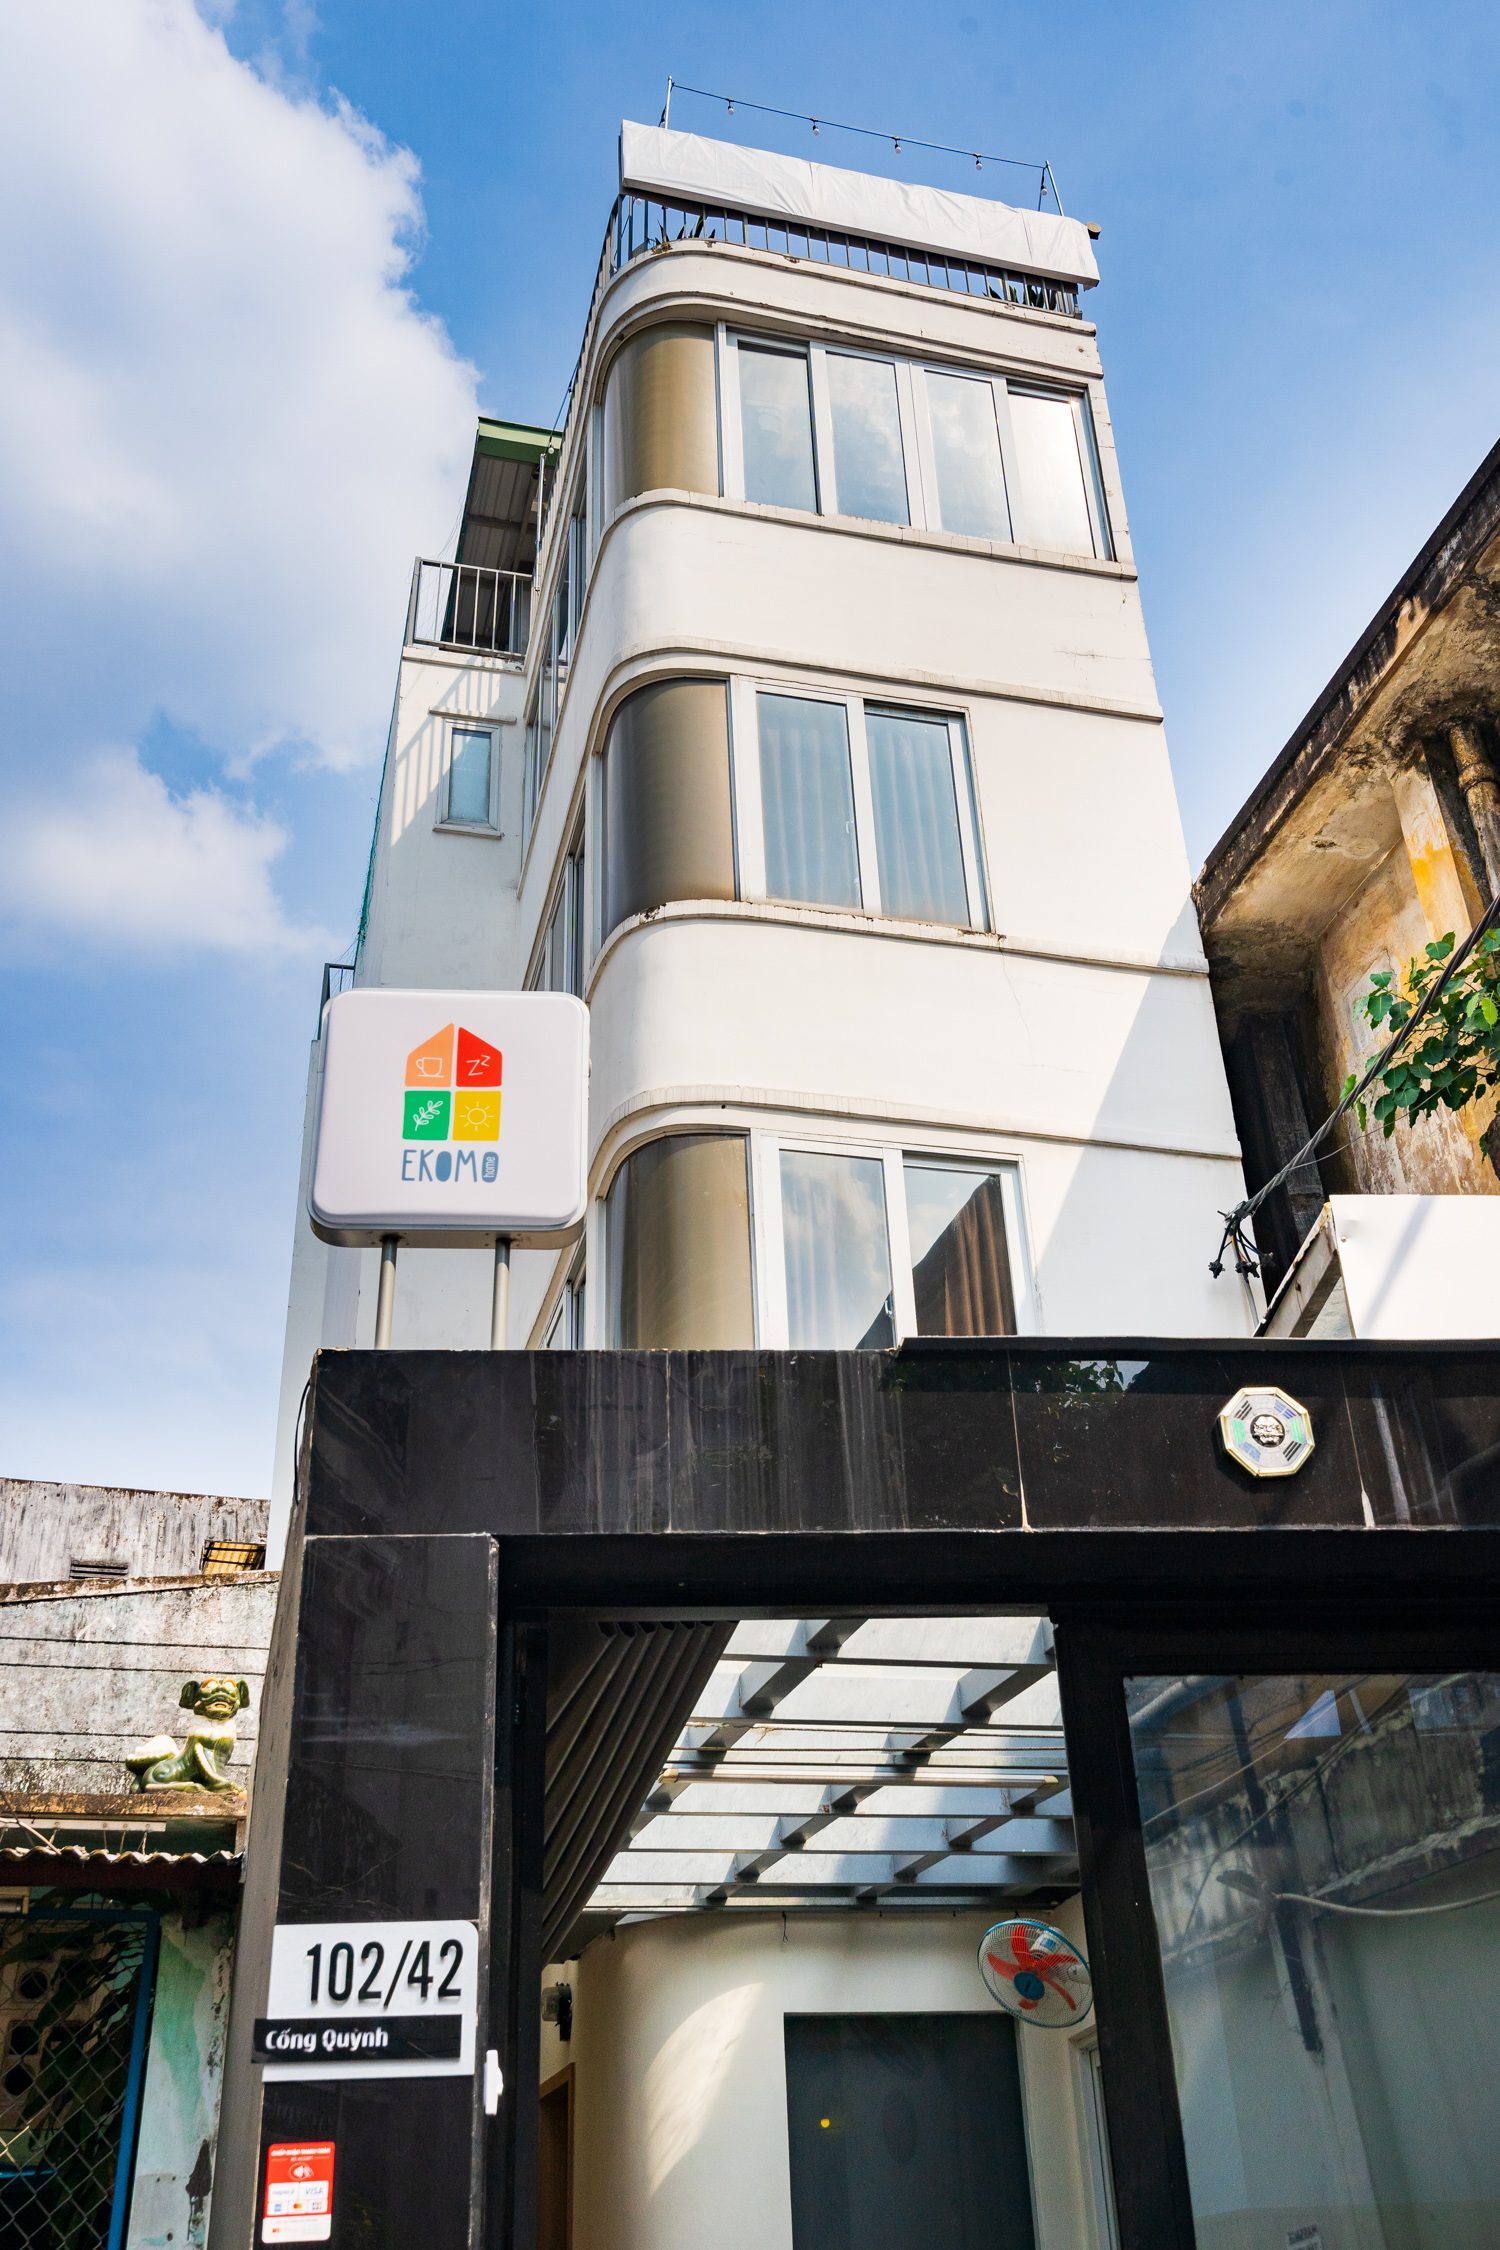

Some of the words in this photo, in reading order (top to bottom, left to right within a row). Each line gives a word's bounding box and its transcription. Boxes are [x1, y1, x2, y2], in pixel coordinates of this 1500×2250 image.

[401, 1149, 499, 1183] EKOMO
[483, 1156, 496, 1178] home
[306, 1939, 464, 2009] 102/42
[265, 2027, 317, 2053] Cống
[322, 2026, 389, 2052] Quỳnh
